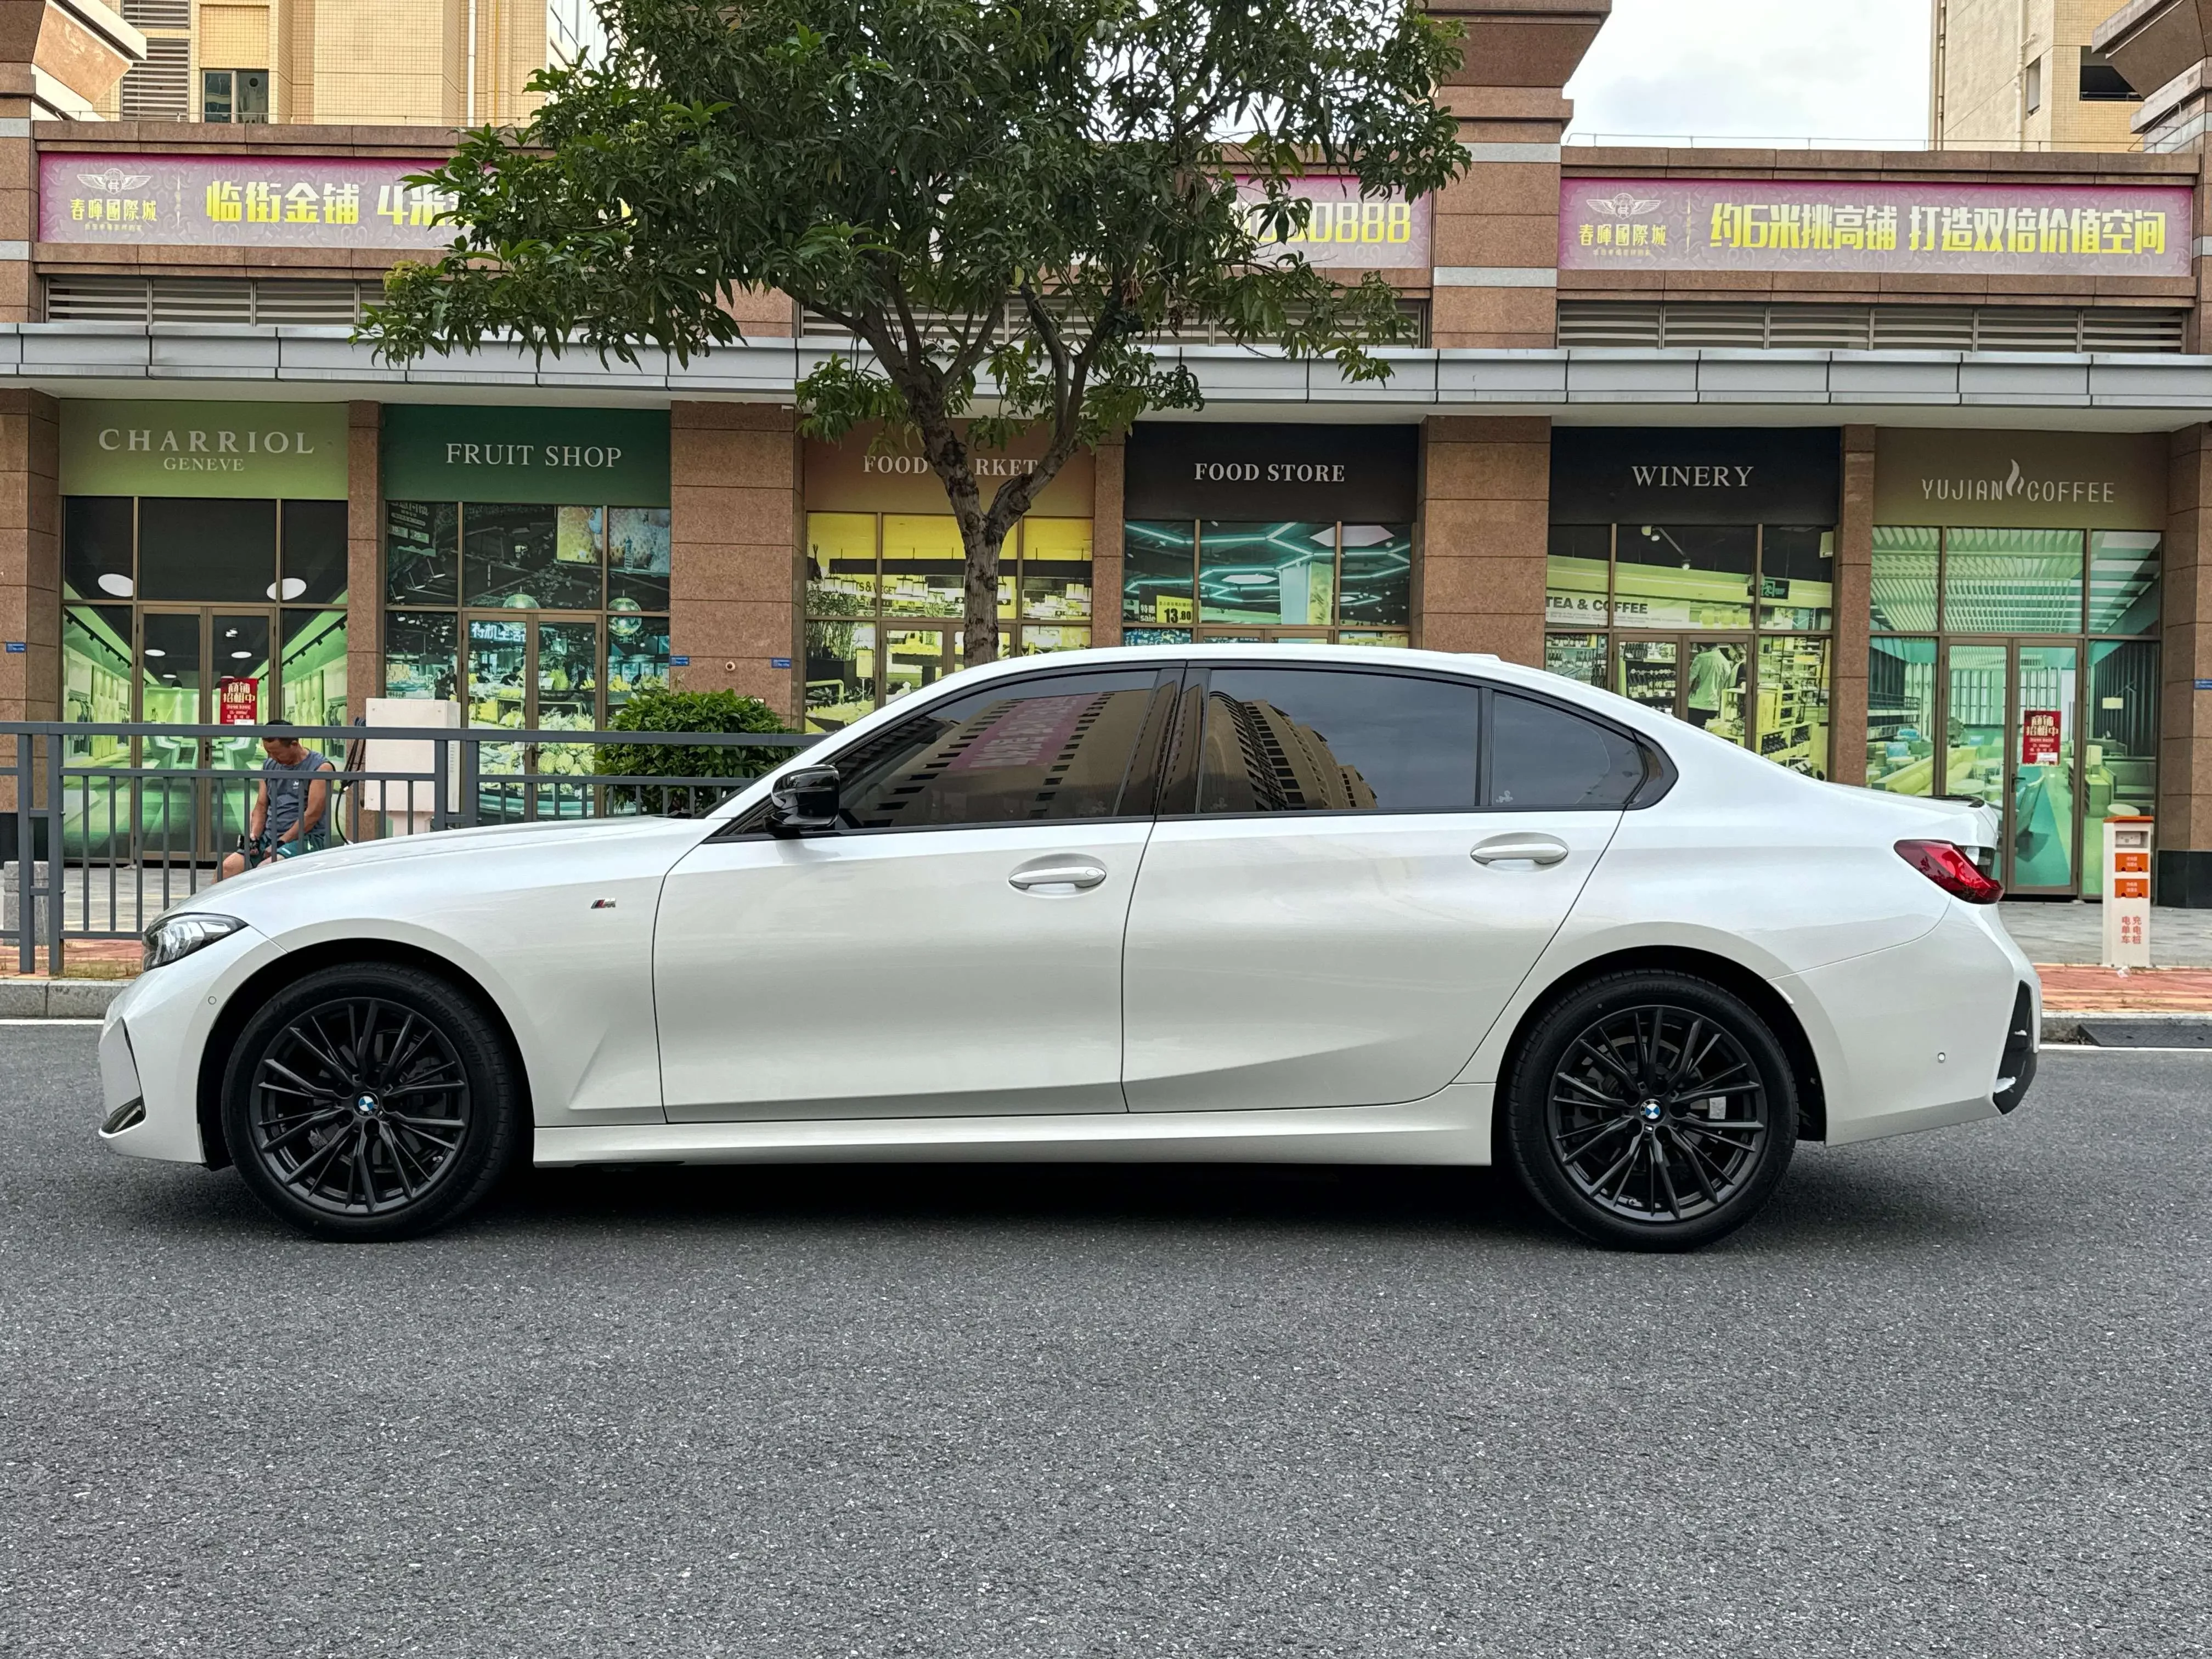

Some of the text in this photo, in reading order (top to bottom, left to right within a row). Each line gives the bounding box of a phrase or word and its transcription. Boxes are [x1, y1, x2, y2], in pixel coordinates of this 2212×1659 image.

[207, 180, 473, 227] 临街金铺 4米
[1710, 202, 2166, 255] 约6米挑高铺 打造双倍价值空间
[98, 428, 314, 454] CHARRIOL
[163, 457, 244, 471] GENEVE
[446, 443, 622, 467] FRUIT SHOP
[863, 455, 1039, 476] FOOD RKET
[1194, 462, 1345, 482] FOOD STORE
[1632, 466, 1754, 487] WINERY
[1921, 478, 2114, 503] YUJIAN COFFEE
[1164, 608, 1192, 624] 13.80
[1546, 596, 1648, 613] TEA & COFFEE
[2121, 916, 2131, 944] 电单车
[2132, 915, 2142, 944] 充电桩
